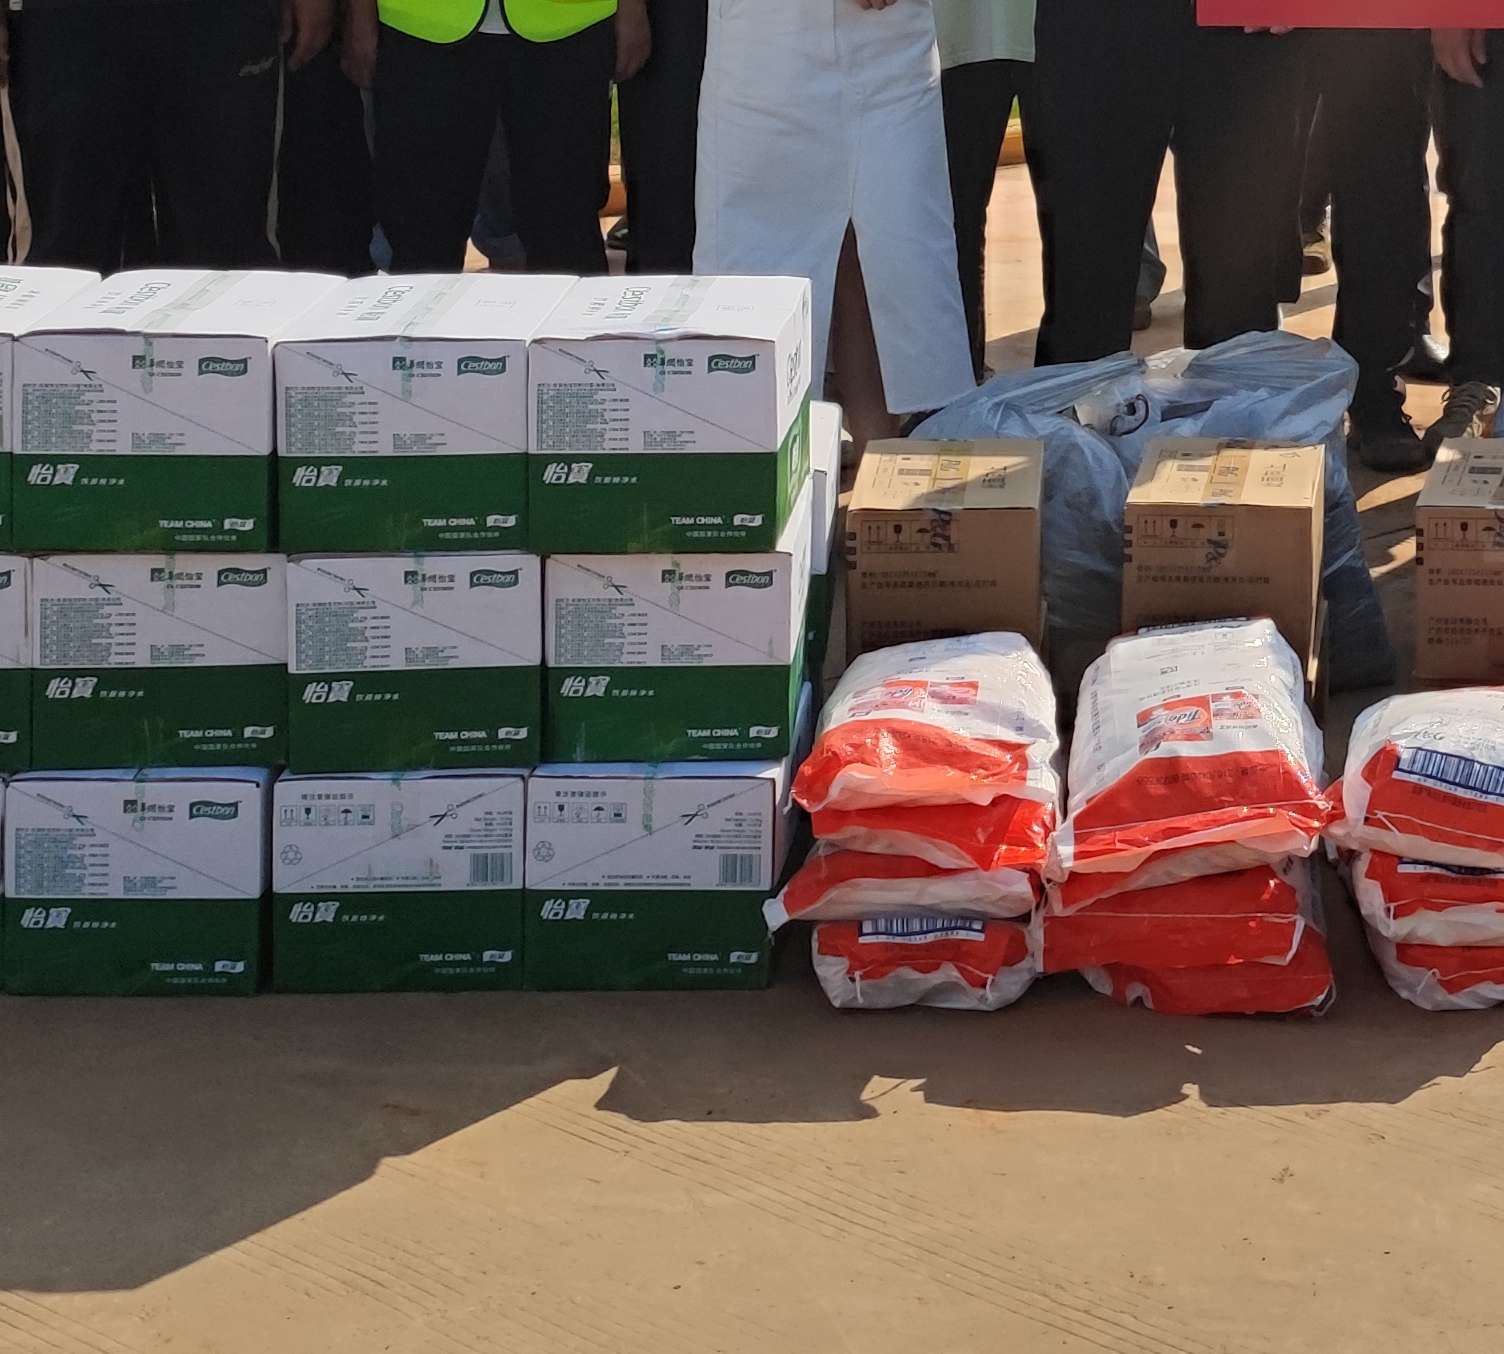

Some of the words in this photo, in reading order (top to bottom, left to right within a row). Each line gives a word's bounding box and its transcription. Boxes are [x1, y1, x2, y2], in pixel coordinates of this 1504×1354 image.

[158, 519, 184, 529] TEAM
[422, 517, 446, 527] TEAM
[670, 516, 694, 526] TEAM
[178, 729, 203, 738] TEAM
[433, 731, 458, 740] TEAM
[687, 729, 711, 737] TEAM
[418, 953, 443, 962] TEAM
[667, 952, 691, 961] TEAM
[150, 962, 175, 971] TEAM
